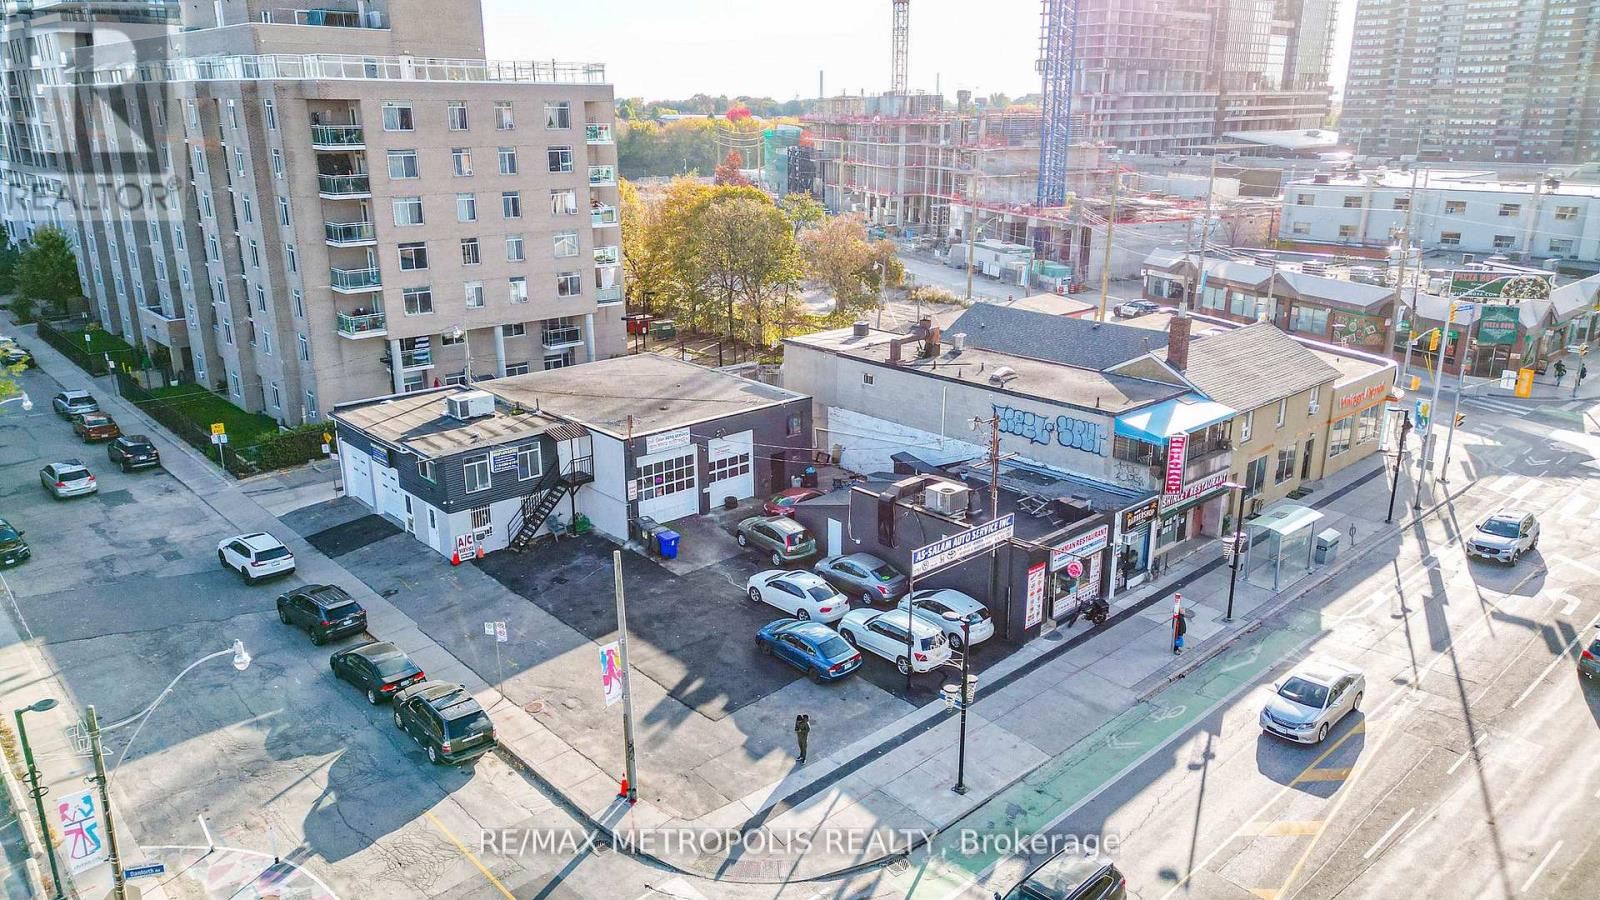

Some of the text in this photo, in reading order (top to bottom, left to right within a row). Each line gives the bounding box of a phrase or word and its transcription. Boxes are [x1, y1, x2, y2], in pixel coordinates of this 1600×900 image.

[1189, 473, 1228, 497] RESTAURANT
[458, 535, 472, 547] A/C
[915, 539, 952, 561] AS-SALAM
[953, 533, 971, 547] AUTO
[971, 520, 998, 540] SERVICE
[999, 516, 1012, 529] INC.
[1076, 527, 1107, 546] RESTAURANT
